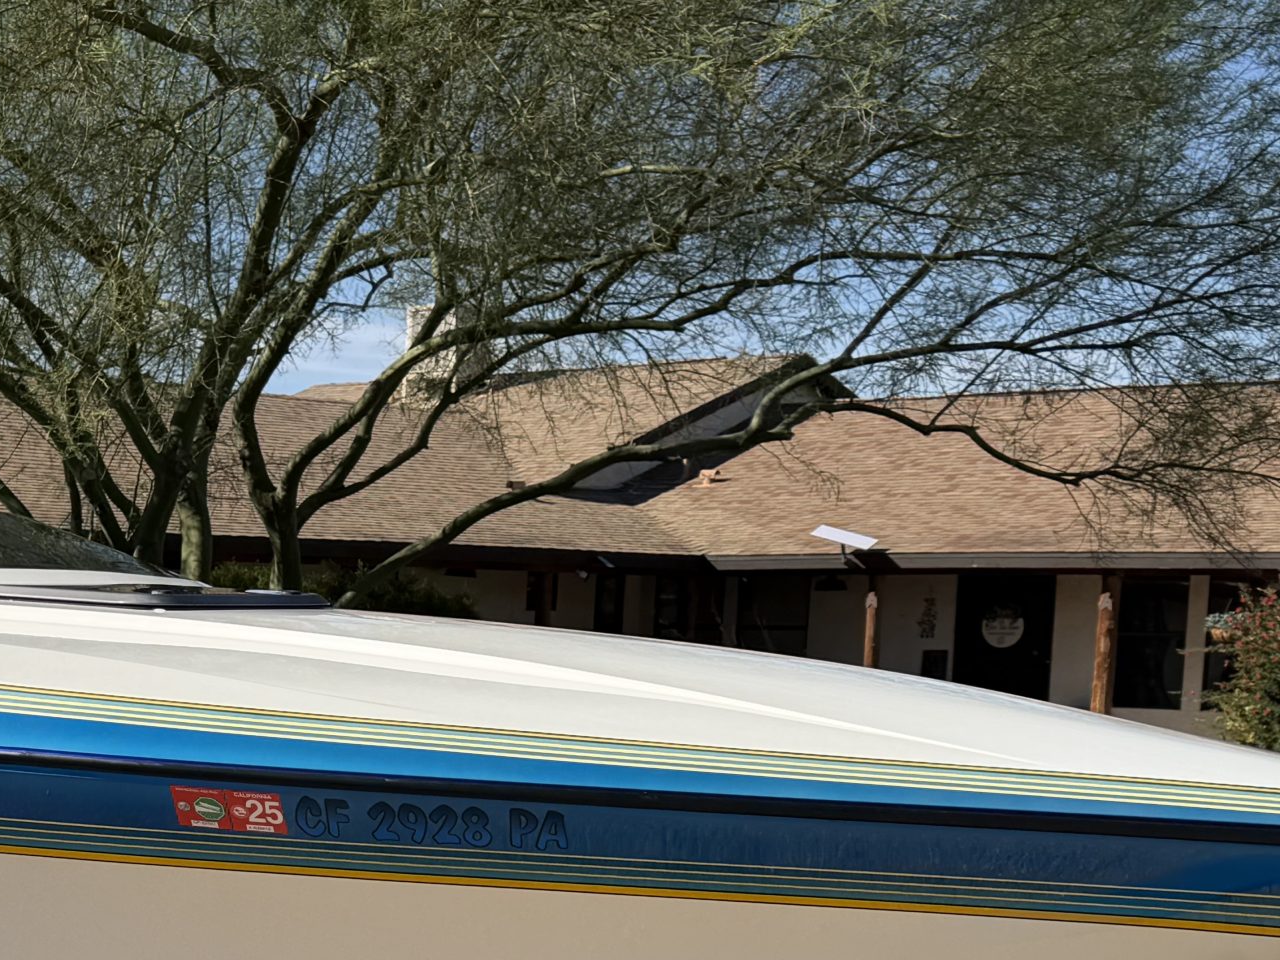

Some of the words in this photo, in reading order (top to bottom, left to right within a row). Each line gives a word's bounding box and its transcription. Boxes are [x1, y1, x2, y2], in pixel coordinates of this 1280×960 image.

[245, 799, 284, 825] 25
[295, 796, 351, 838] CF
[367, 801, 493, 848] 2928
[509, 807, 568, 850] PA
